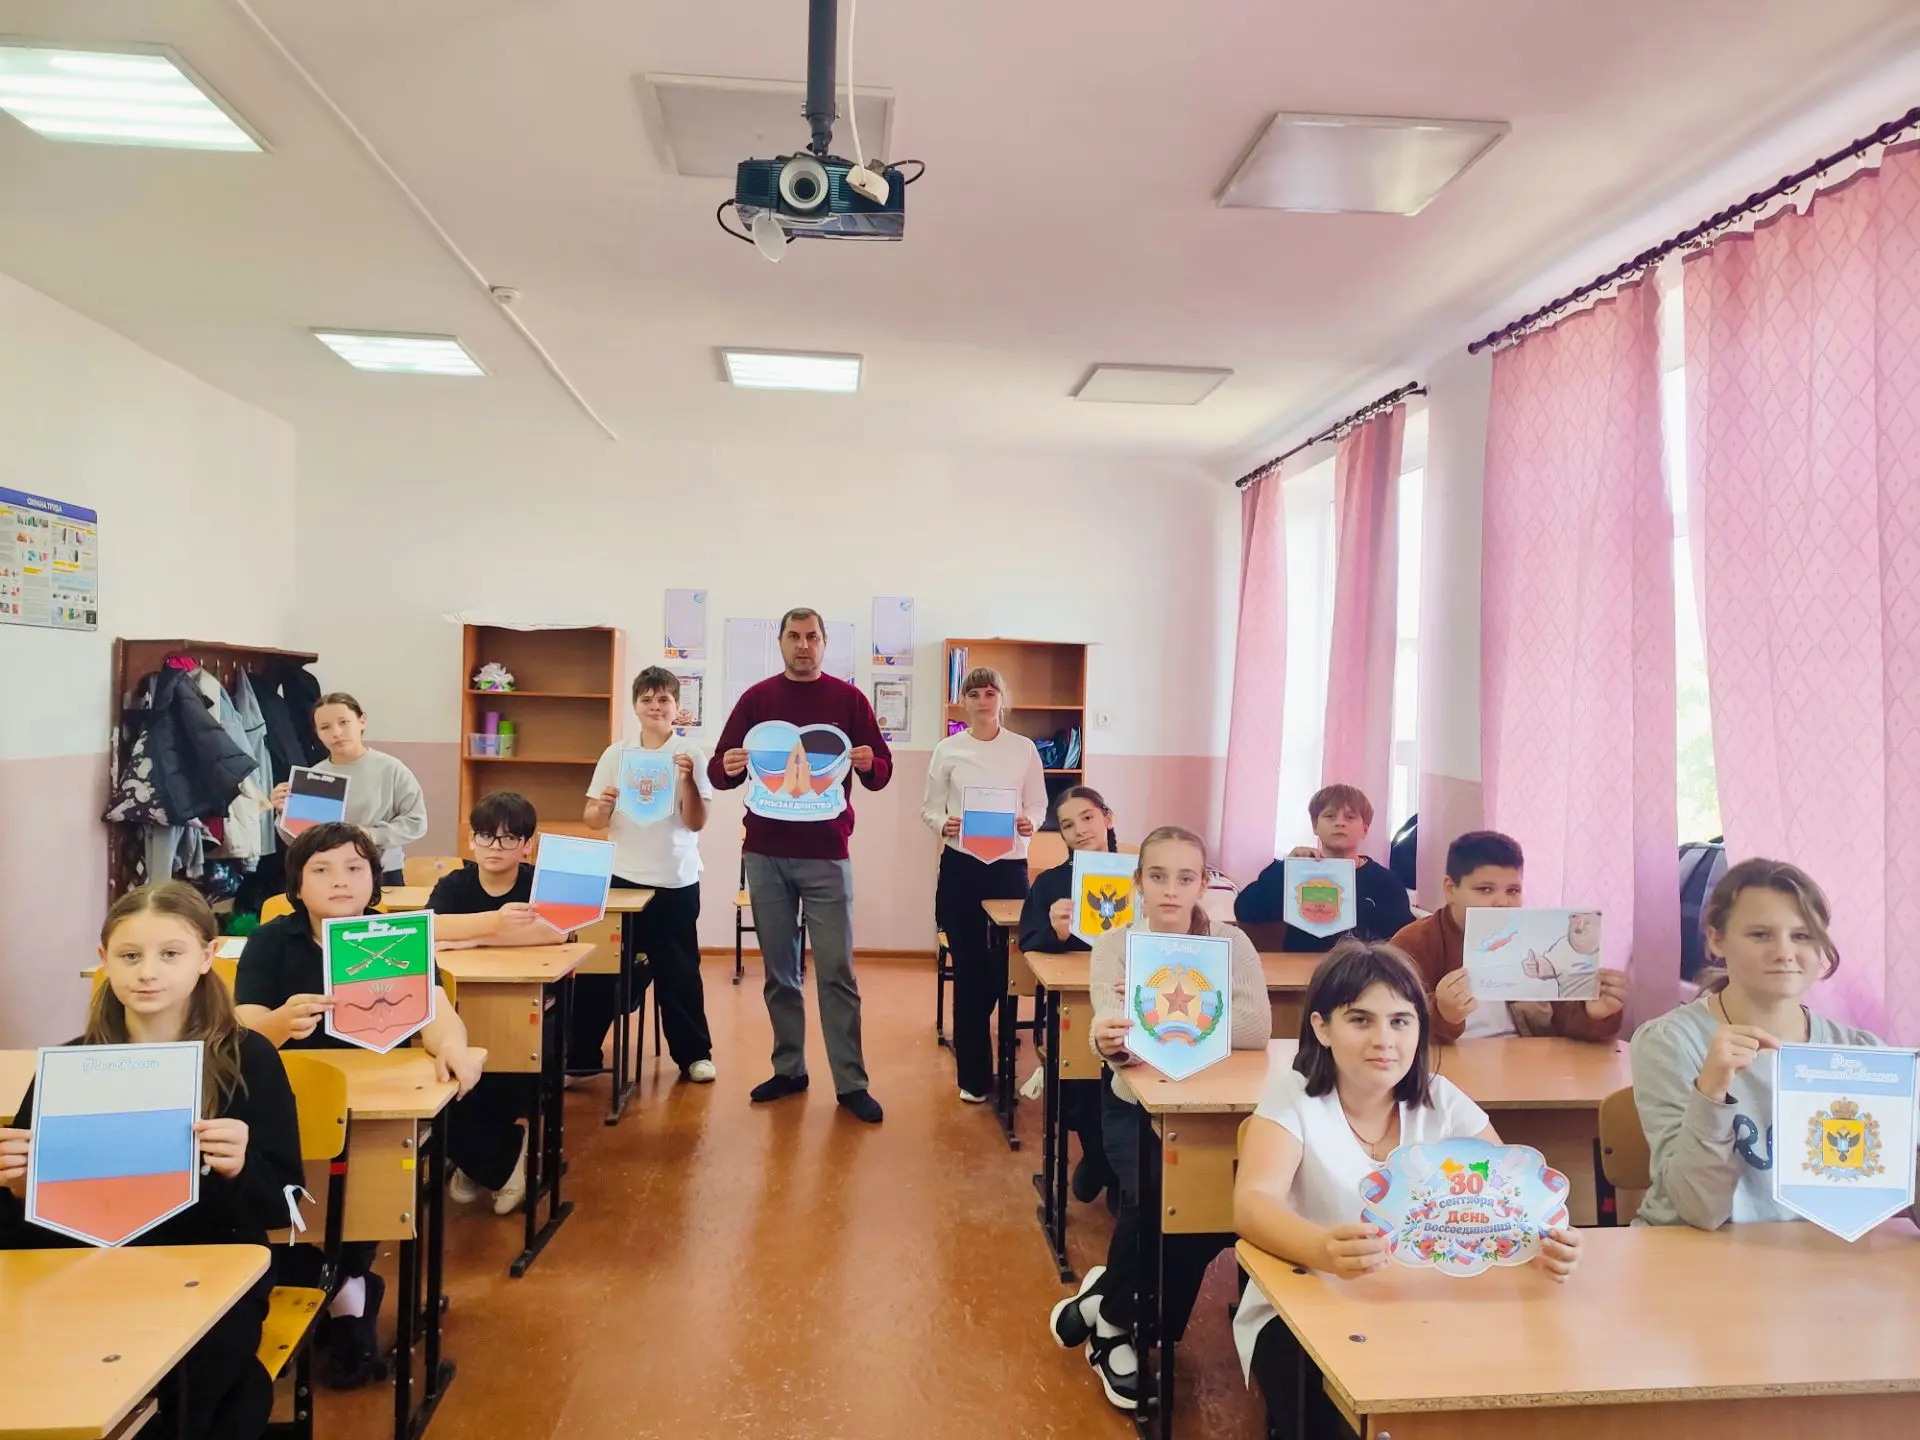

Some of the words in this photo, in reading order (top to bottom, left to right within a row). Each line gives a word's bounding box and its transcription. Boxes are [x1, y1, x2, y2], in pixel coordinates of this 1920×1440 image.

[1449, 1172, 1484, 1196] 30
[1438, 1194, 1495, 1210] сентября
[1445, 1208, 1490, 1224] День
